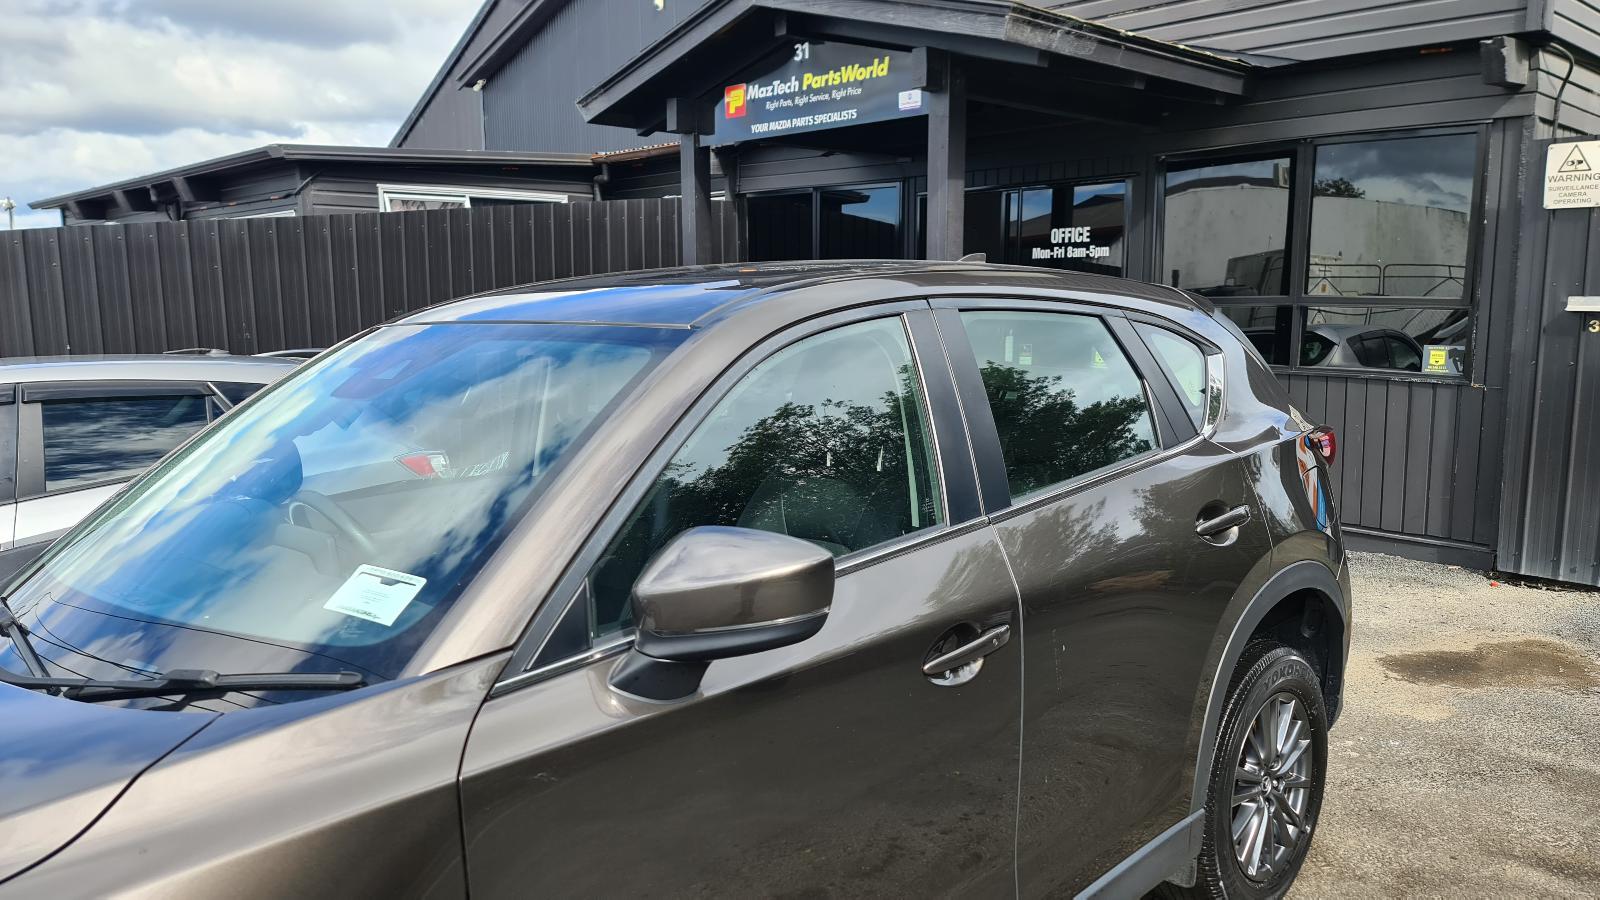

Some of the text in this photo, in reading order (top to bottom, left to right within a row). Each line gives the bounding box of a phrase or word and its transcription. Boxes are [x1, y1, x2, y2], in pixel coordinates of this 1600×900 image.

[793, 42, 809, 61] 31
[747, 56, 890, 100] MazTech PartsWorld
[765, 87, 862, 111] Right Parts, Right Service, Right Price
[750, 109, 858, 133] YOUR MAZDA PARTS SPECIALISTS
[1548, 173, 1600, 183] WARNING
[1548, 184, 1599, 192] SURVEILLANCE
[1050, 226, 1091, 243] OFFICE
[1032, 245, 1110, 259] Mon-Fri 8am-5pm
